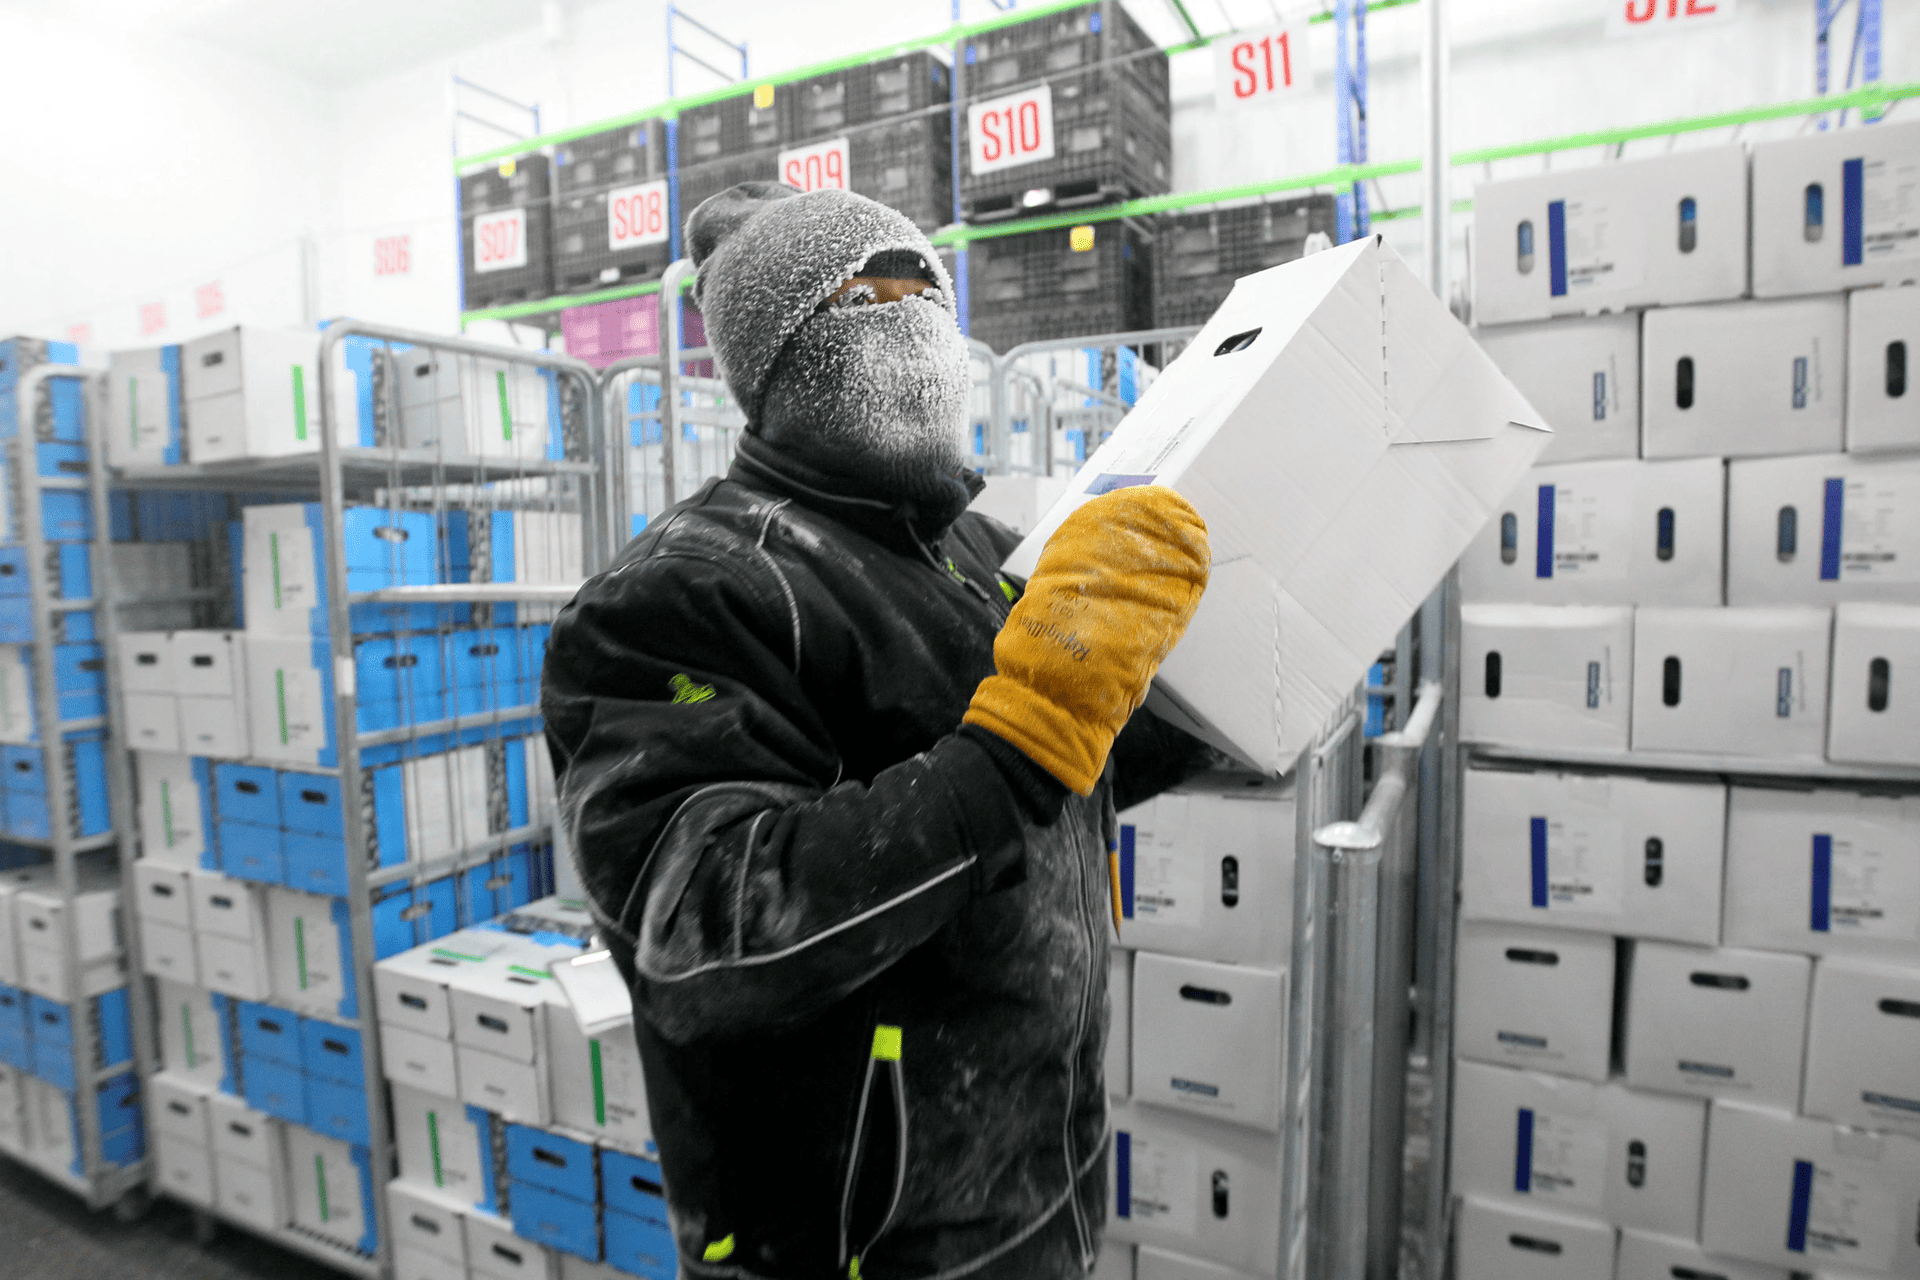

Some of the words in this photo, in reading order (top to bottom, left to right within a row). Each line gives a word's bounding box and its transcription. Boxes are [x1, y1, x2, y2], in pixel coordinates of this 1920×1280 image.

[1231, 31, 1292, 99] S11
[981, 100, 1041, 162] S10
[479, 217, 520, 263] S07
[613, 190, 662, 240] S08
